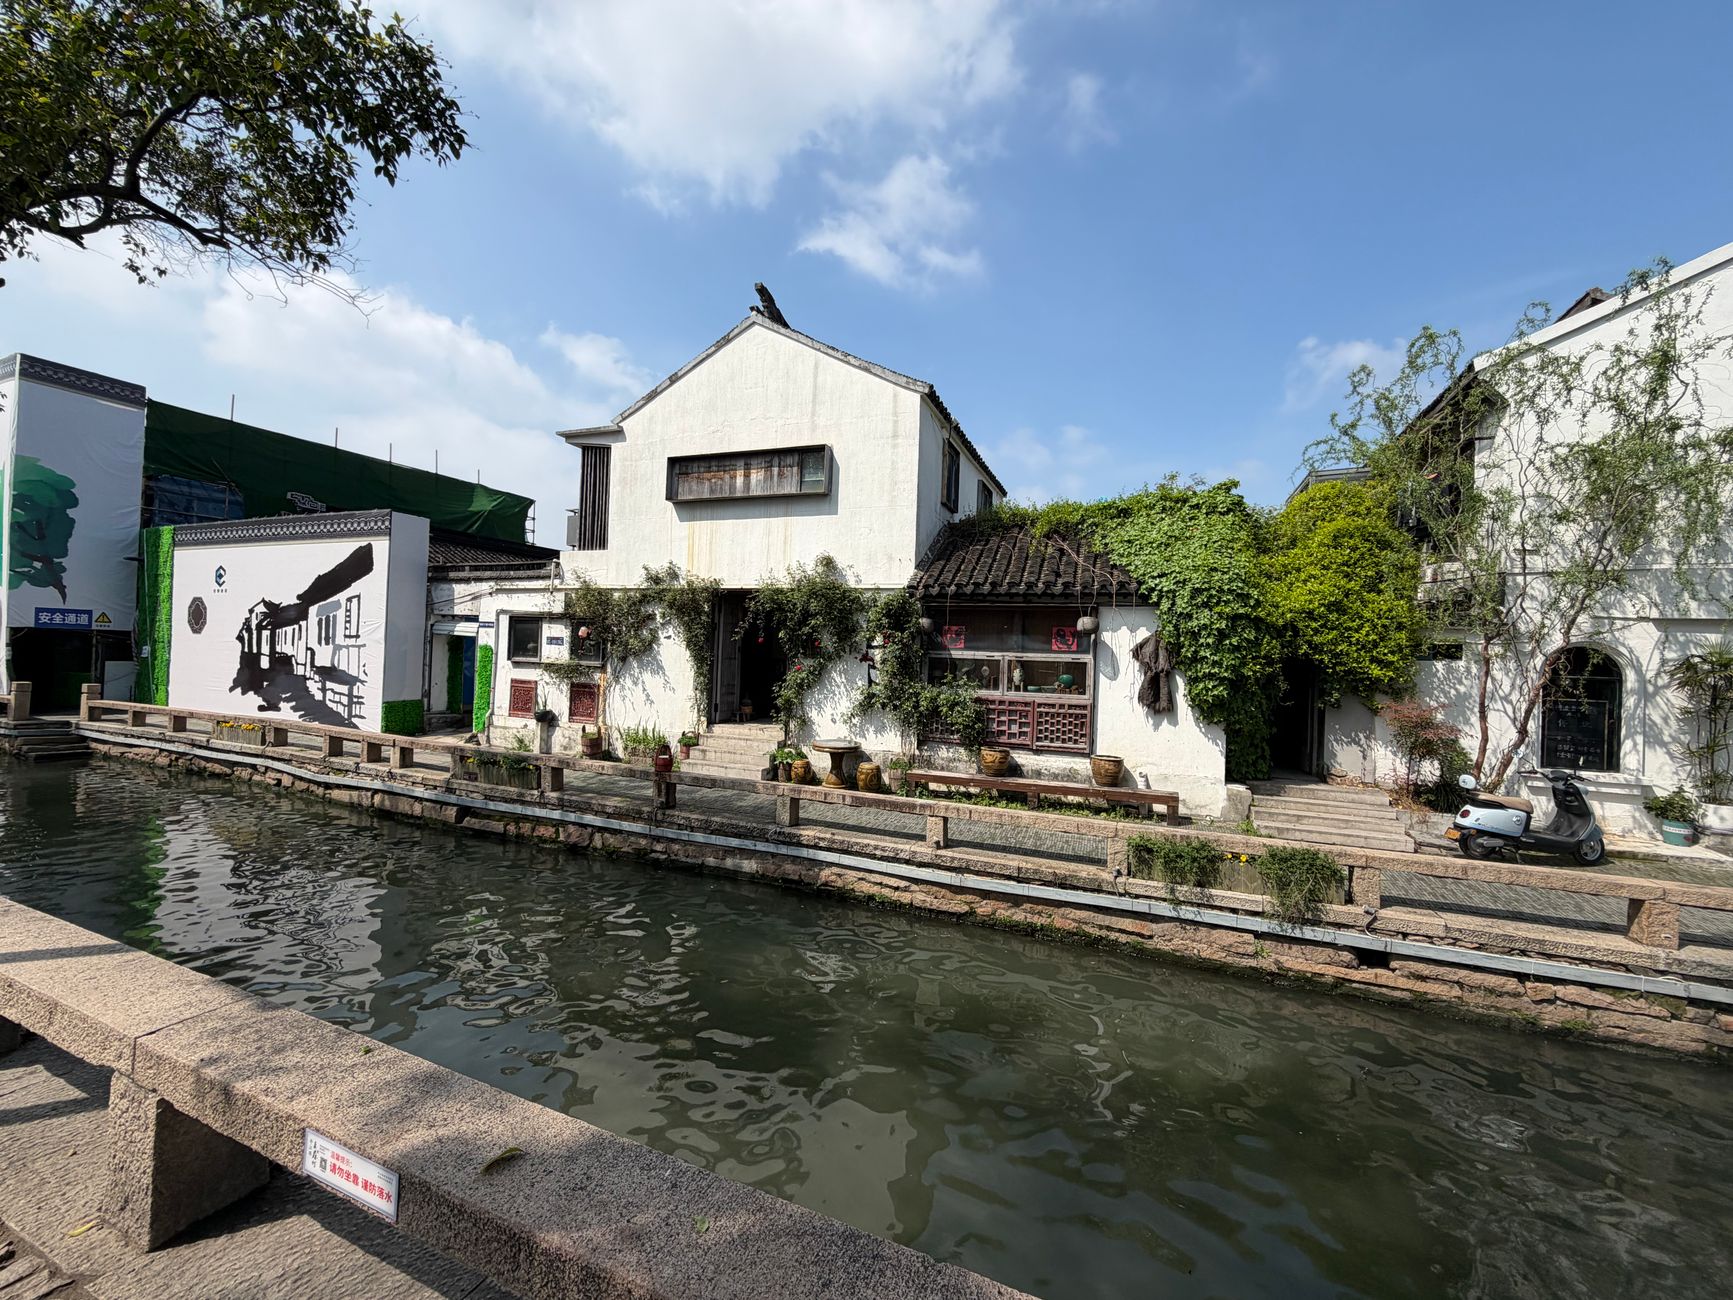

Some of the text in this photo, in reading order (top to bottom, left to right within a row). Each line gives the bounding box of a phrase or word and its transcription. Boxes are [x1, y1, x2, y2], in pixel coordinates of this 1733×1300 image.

[38, 612, 89, 625] 安全通道
[329, 1161, 359, 1186] 请勿坐靠
[361, 1177, 392, 1203] 谨防落水
